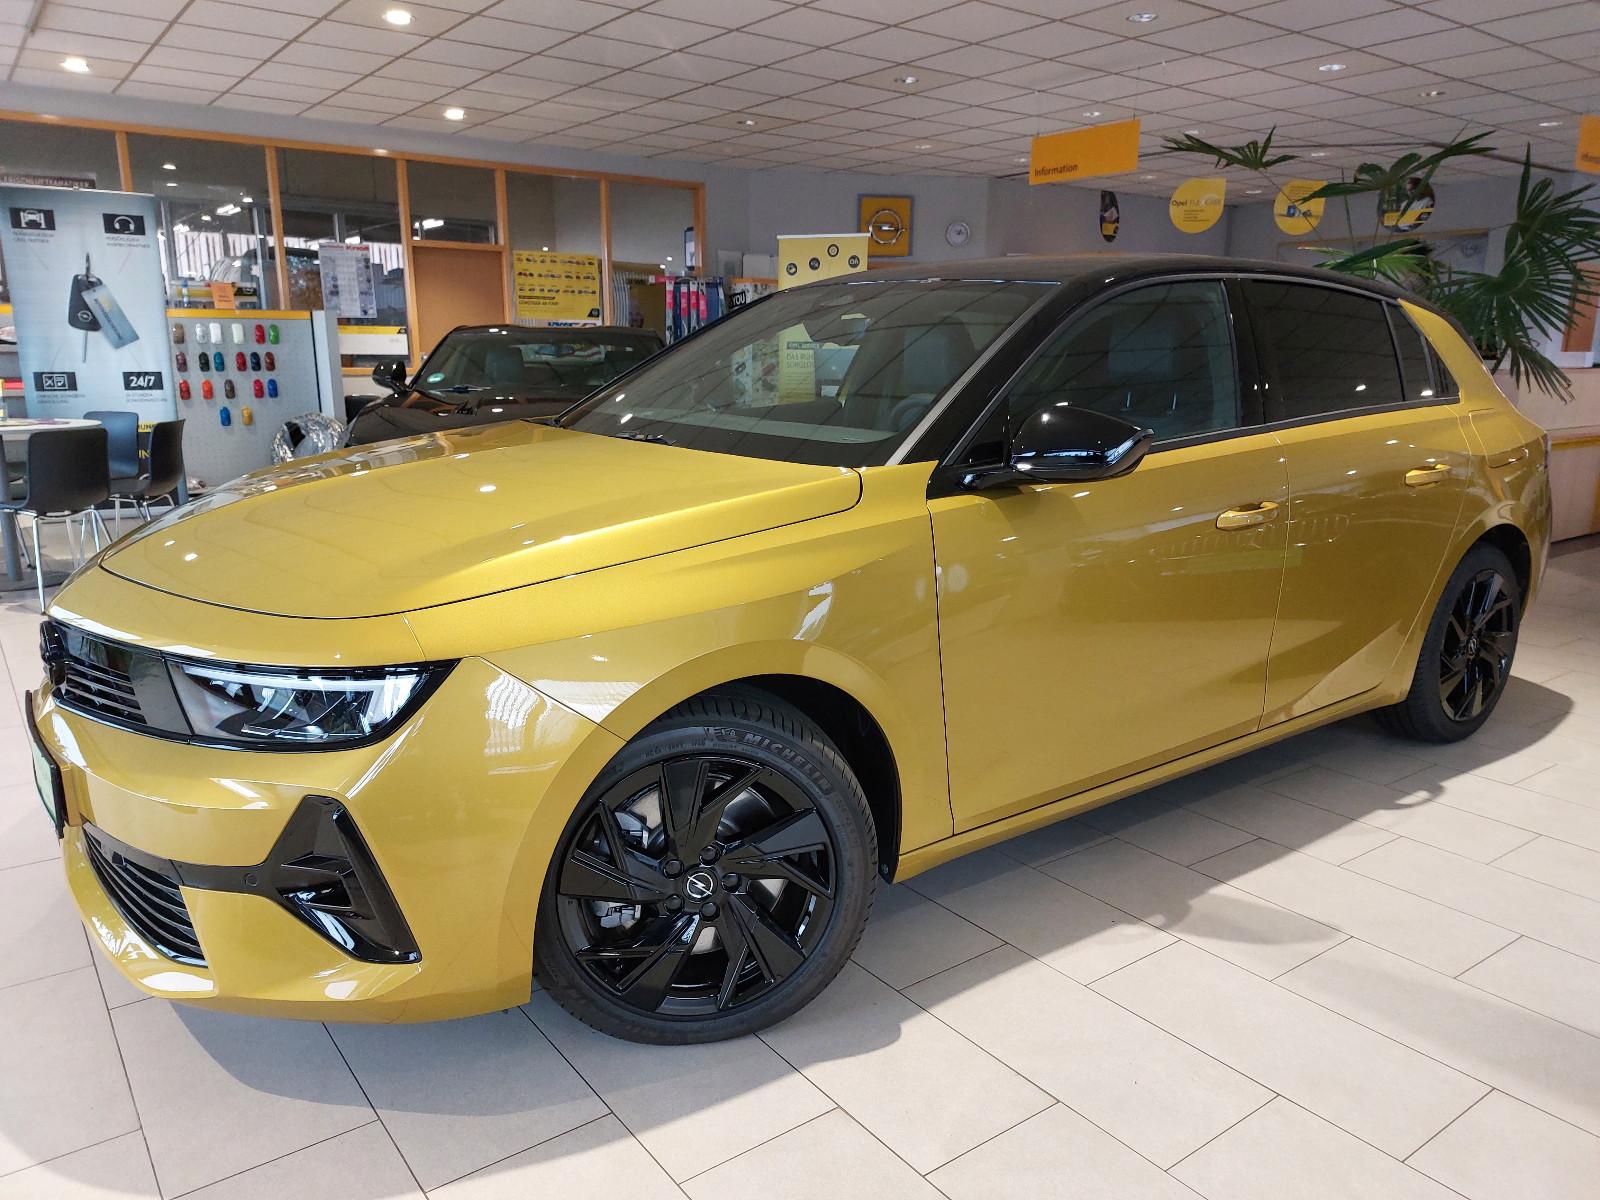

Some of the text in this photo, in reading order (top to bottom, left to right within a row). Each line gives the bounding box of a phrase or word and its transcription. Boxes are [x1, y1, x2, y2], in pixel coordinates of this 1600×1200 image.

[1034, 163, 1079, 177] Information
[1171, 199, 1188, 208] Opel
[129, 375, 156, 388] 24/7
[743, 733, 833, 795] MICHELIN
